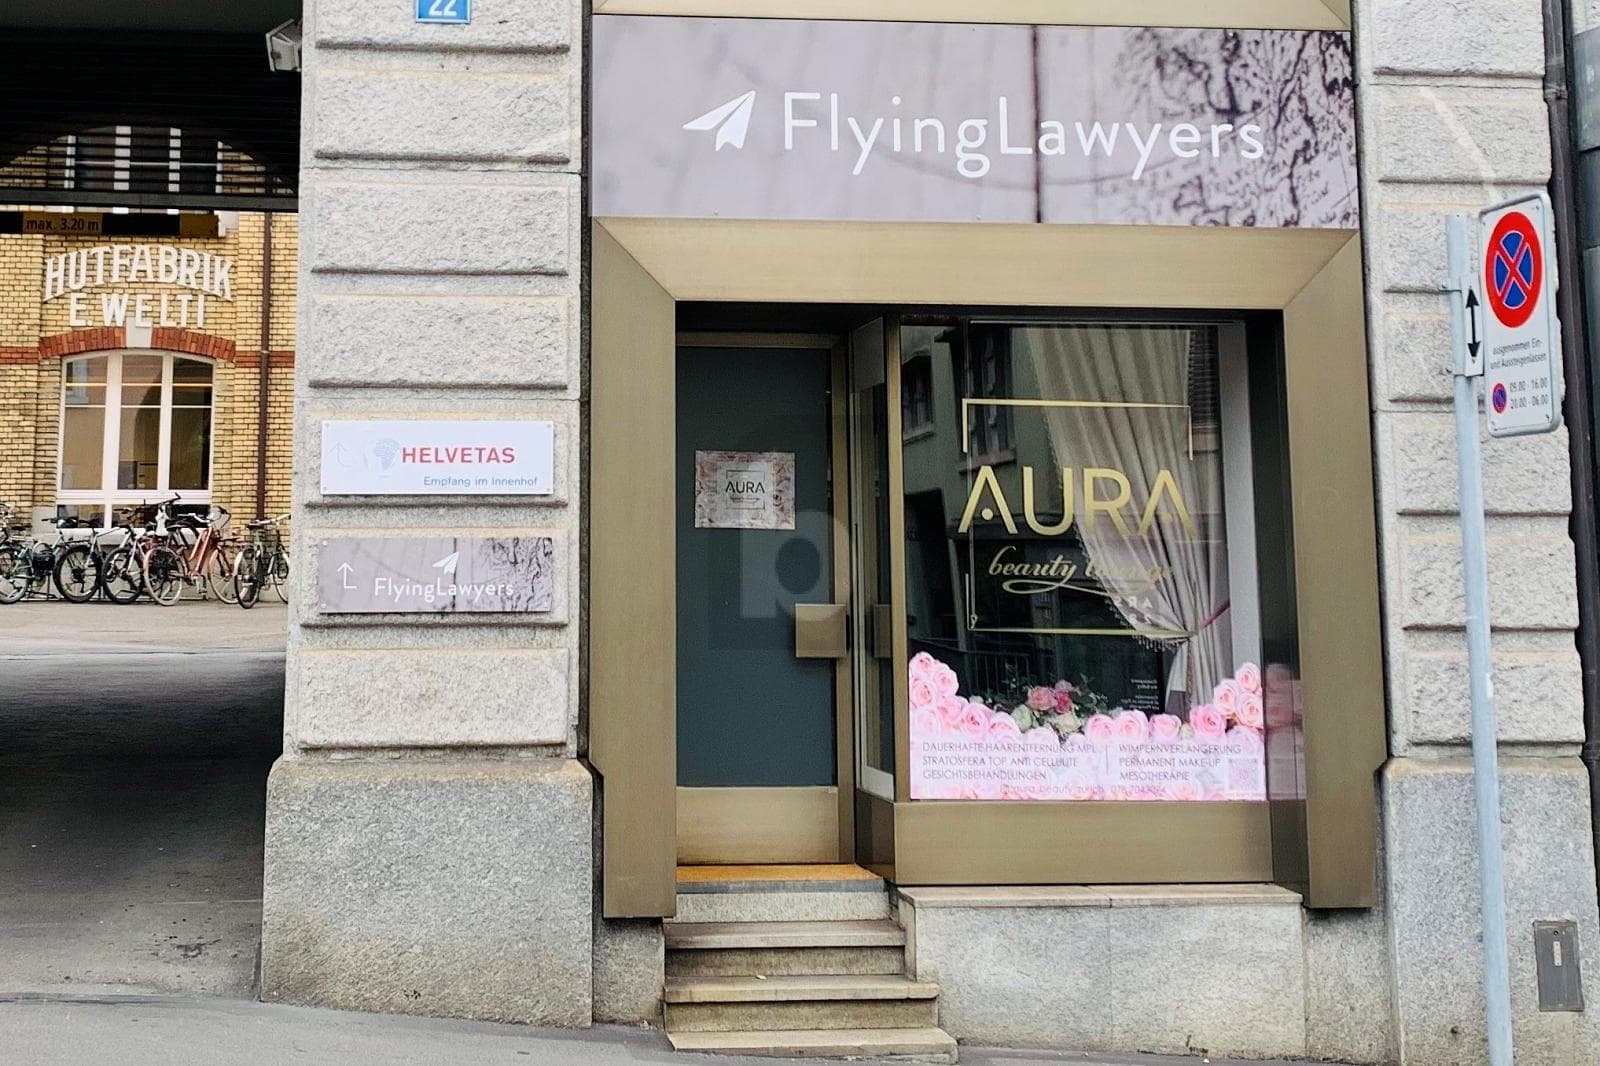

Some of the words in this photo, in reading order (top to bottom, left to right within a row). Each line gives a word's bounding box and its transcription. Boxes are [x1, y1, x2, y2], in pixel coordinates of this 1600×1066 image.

[784, 91, 1265, 180] FlyingLawyers
[26, 218, 57, 231] max.
[60, 217, 85, 231] 3.20
[86, 220, 99, 231] m
[43, 244, 236, 302] HUTFABRIK
[102, 293, 205, 328] WELTI
[402, 447, 516, 464] HELVETAS
[423, 476, 471, 487] Empfang
[475, 475, 488, 486] im
[491, 476, 538, 486] Innenhof
[725, 481, 766, 494] AURA
[957, 465, 1197, 538] AURA
[988, 545, 1078, 595] beauty
[374, 577, 514, 602] FlyingLawyers
